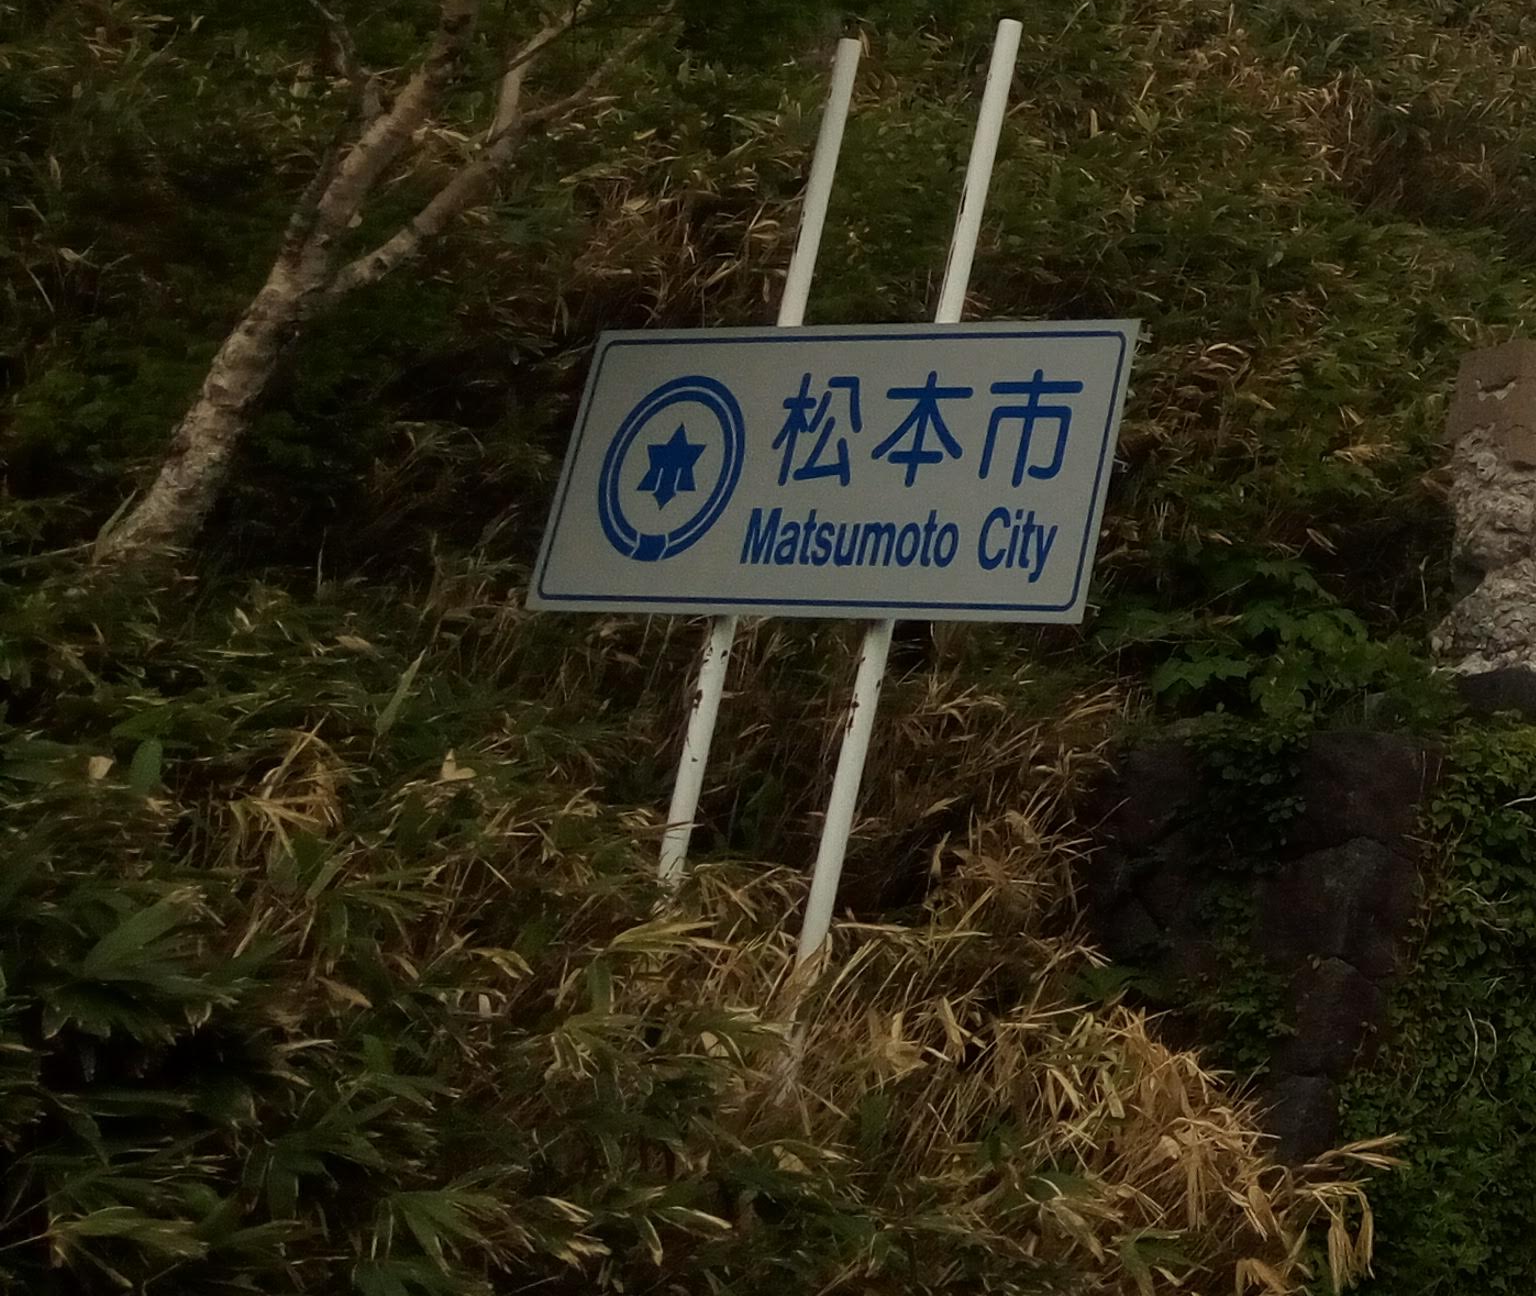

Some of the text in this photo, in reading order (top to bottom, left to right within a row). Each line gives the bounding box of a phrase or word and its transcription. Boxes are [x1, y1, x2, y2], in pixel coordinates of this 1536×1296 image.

[772, 368, 1084, 487] 松本市
[740, 507, 1058, 583] Matsumoto City
